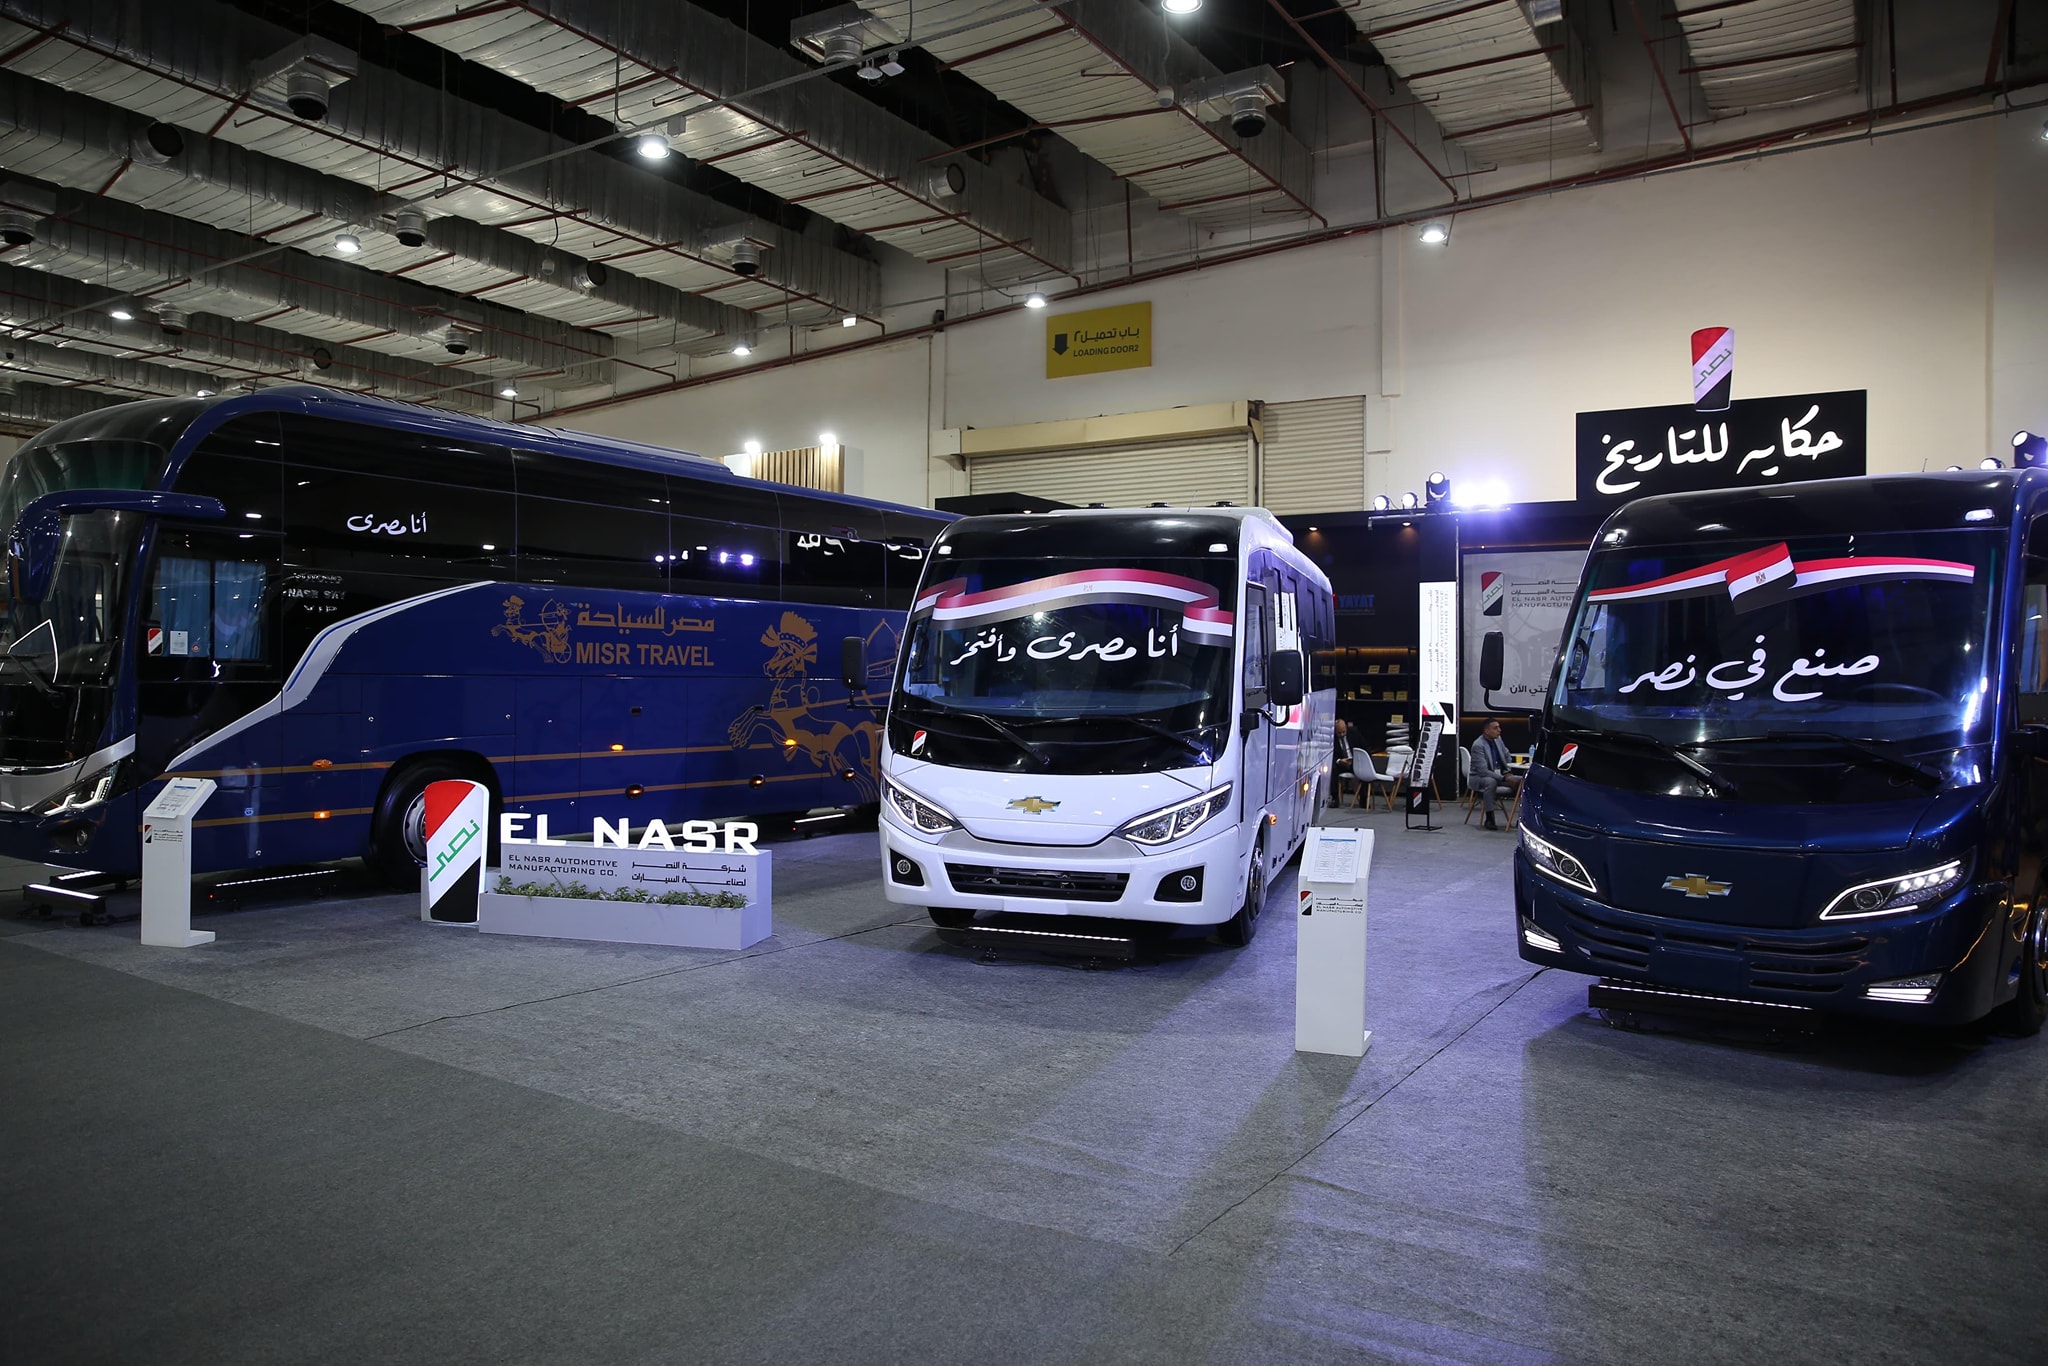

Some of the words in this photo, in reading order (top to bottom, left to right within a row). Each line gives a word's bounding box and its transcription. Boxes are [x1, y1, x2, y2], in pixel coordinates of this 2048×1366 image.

[1119, 327, 1140, 340] باب
[1073, 346, 1109, 357] LOADING
[1595, 421, 1730, 495] للتاريخ
[411, 511, 427, 534] أنا
[576, 601, 665, 635] للسياحة
[662, 616, 715, 637] مصر
[576, 642, 631, 665] MISR
[636, 643, 715, 667] TRAVEL
[1148, 623, 1179, 658] أنا
[1618, 654, 1697, 694] نصر
[1705, 634, 1767, 701] في
[1772, 648, 1880, 702] صنع
[501, 813, 567, 846] EL
[593, 816, 760, 856] NASR
[508, 863, 595, 876] MANUFACTURING
[600, 869, 618, 877] CO.
[524, 855, 551, 864] NASR
[554, 856, 618, 868] AUTOMOTIVE
